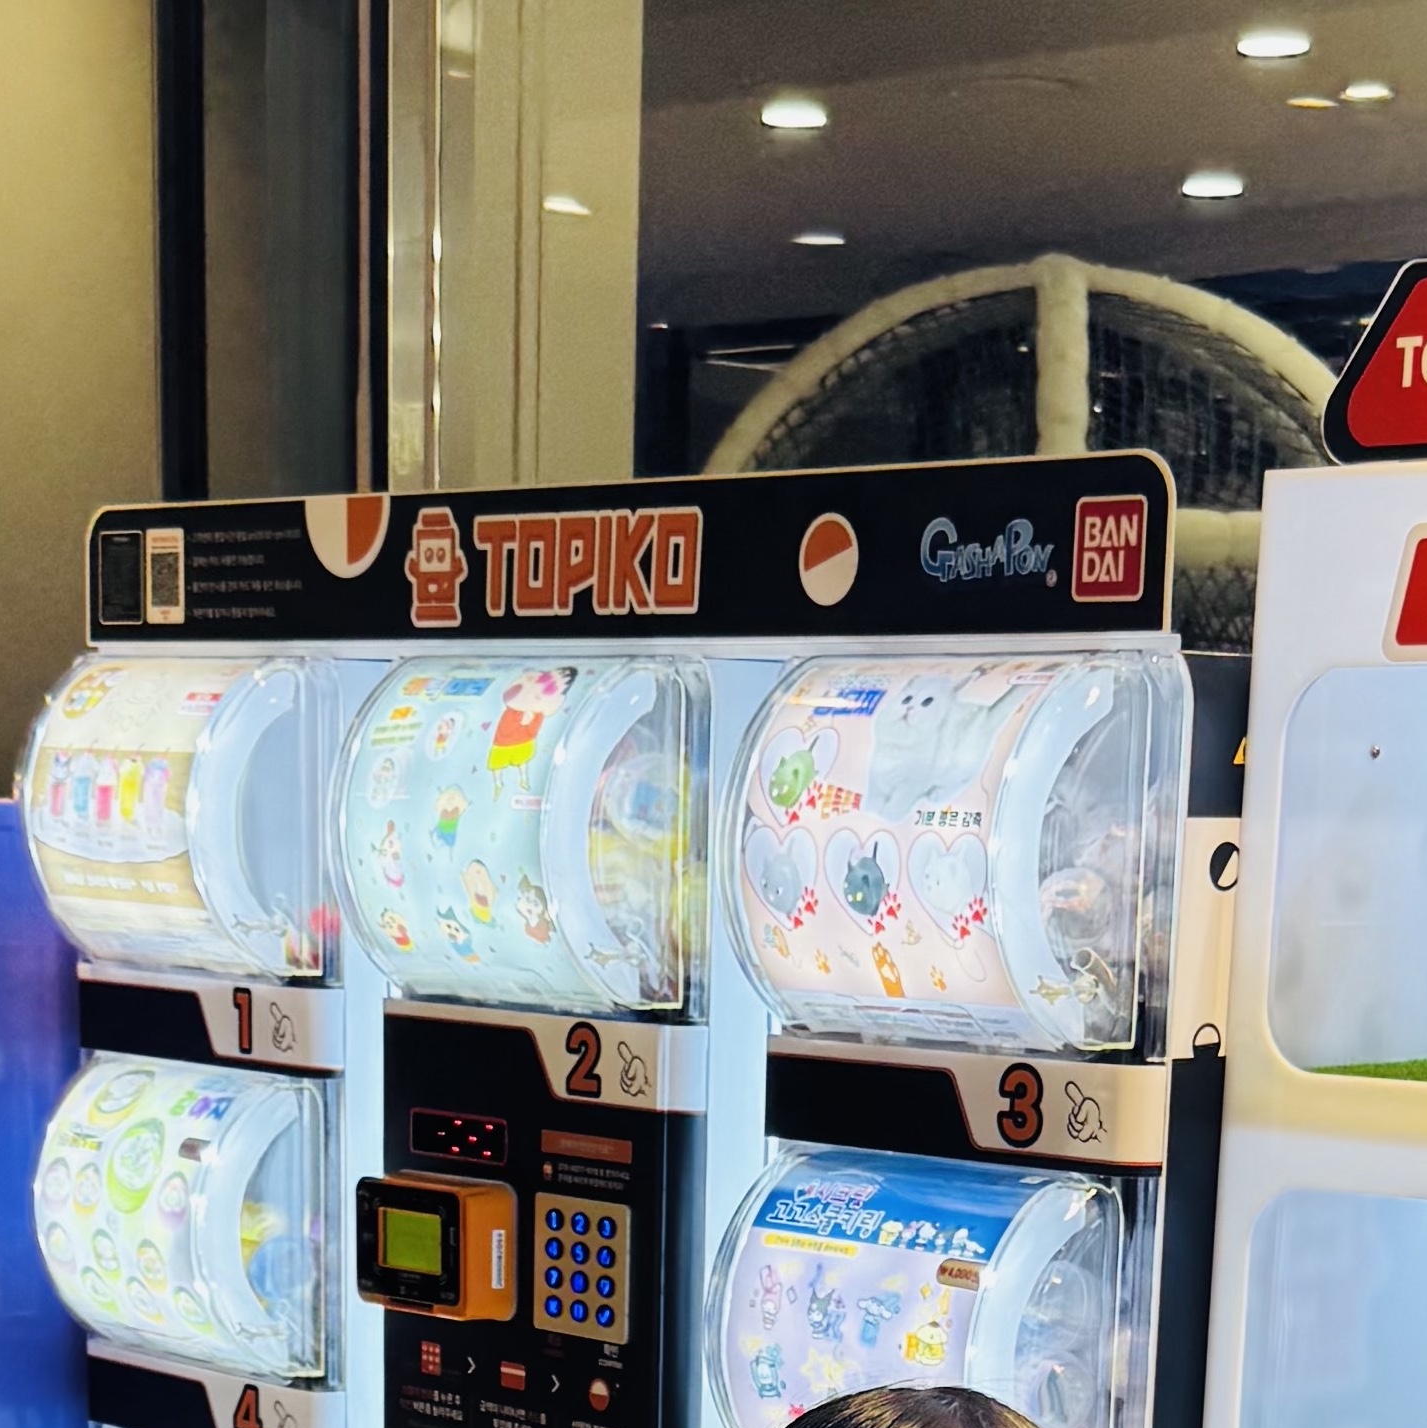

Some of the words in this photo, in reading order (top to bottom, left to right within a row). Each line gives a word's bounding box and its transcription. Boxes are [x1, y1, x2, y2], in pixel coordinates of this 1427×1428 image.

[474, 506, 703, 618] TOPIKO
[1081, 550, 1125, 583] DAI
[1083, 514, 1139, 549] BAN
[232, 986, 253, 1054] 1
[565, 1021, 602, 1098] 2
[996, 1061, 1044, 1148] 3
